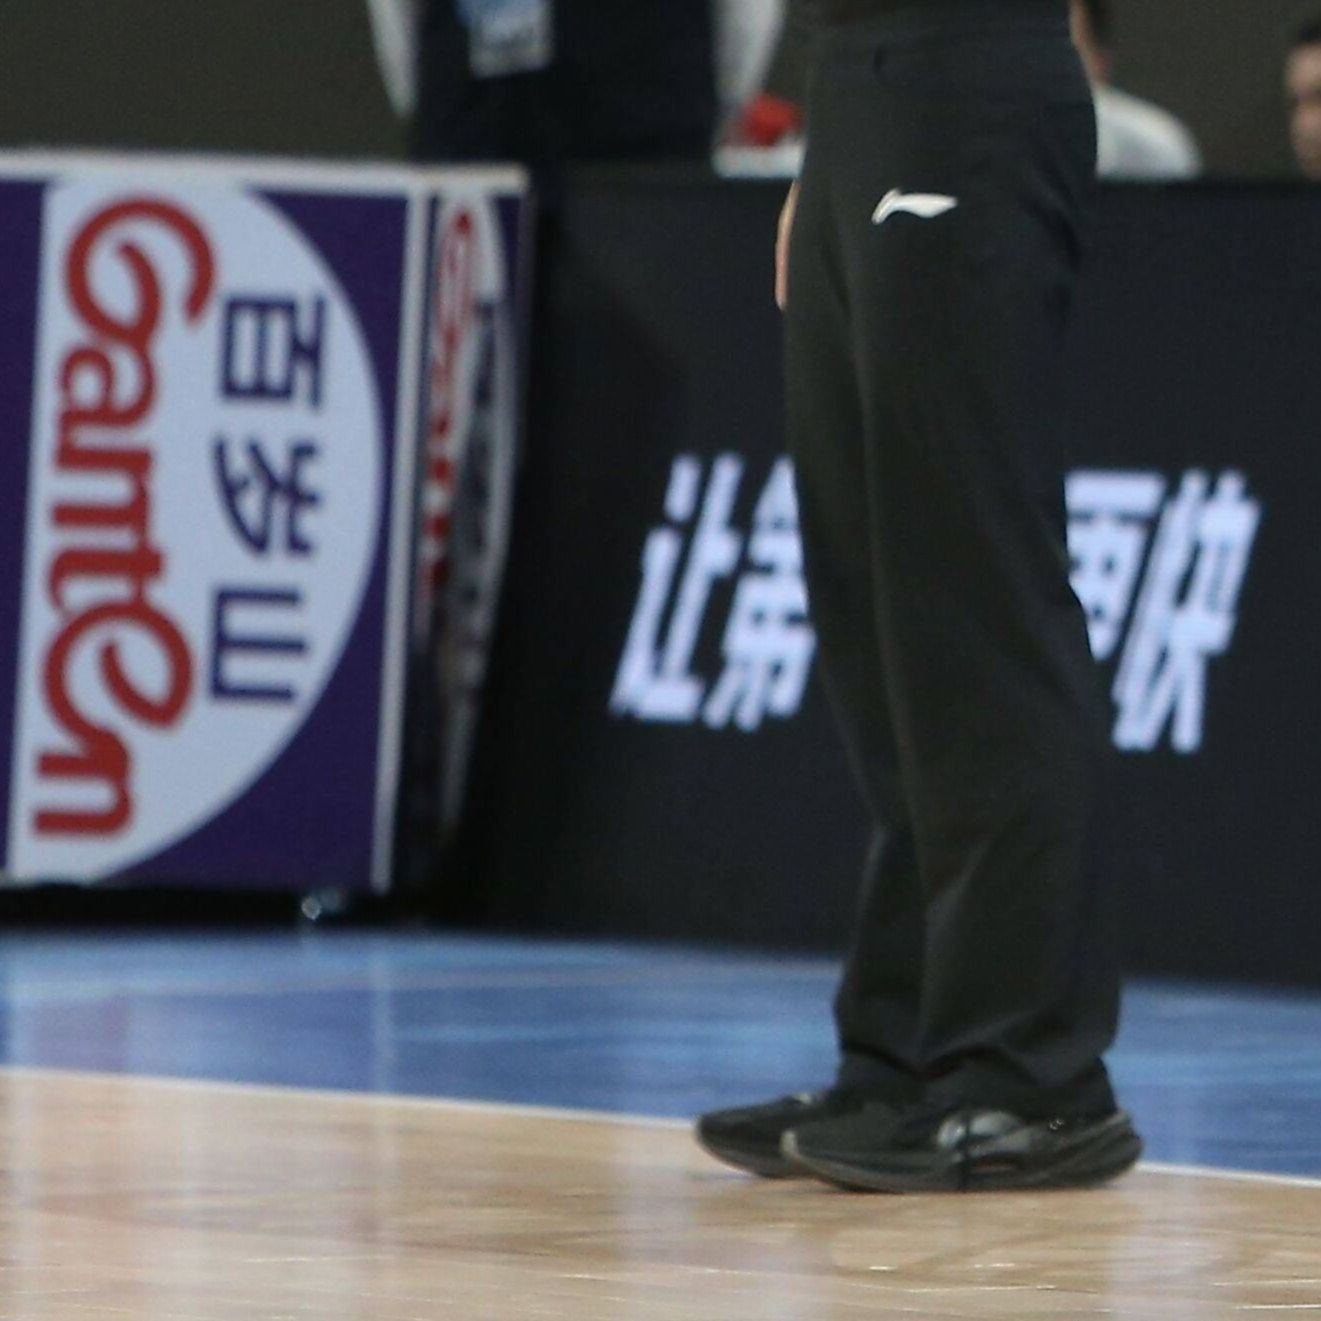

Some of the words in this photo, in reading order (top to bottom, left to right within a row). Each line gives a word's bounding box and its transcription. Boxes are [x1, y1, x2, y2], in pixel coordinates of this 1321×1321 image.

[32, 194, 217, 841] Ganten
[208, 292, 327, 703] 百岁山
